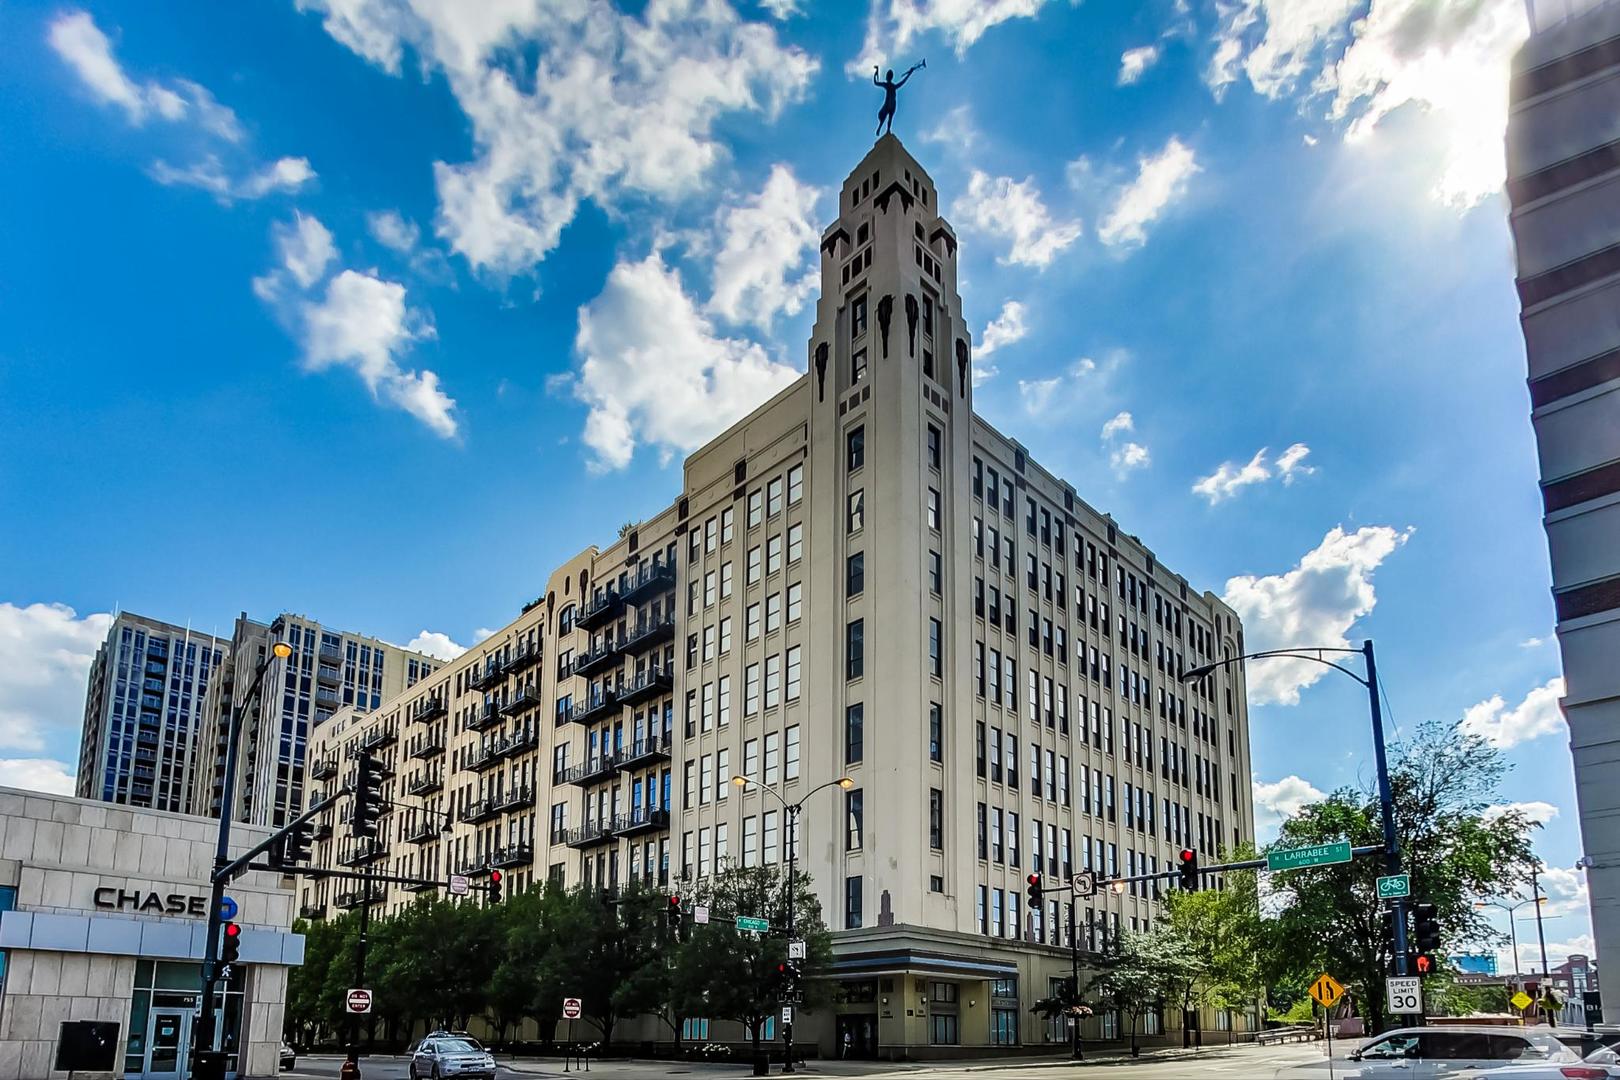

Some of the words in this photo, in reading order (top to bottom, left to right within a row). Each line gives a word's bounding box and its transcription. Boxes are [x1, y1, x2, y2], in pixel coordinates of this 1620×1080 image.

[1284, 847, 1330, 861] LARRABEE
[93, 887, 208, 916] CHASE
[1390, 980, 1417, 988] SPEED
[1393, 995, 1417, 1008] 30
